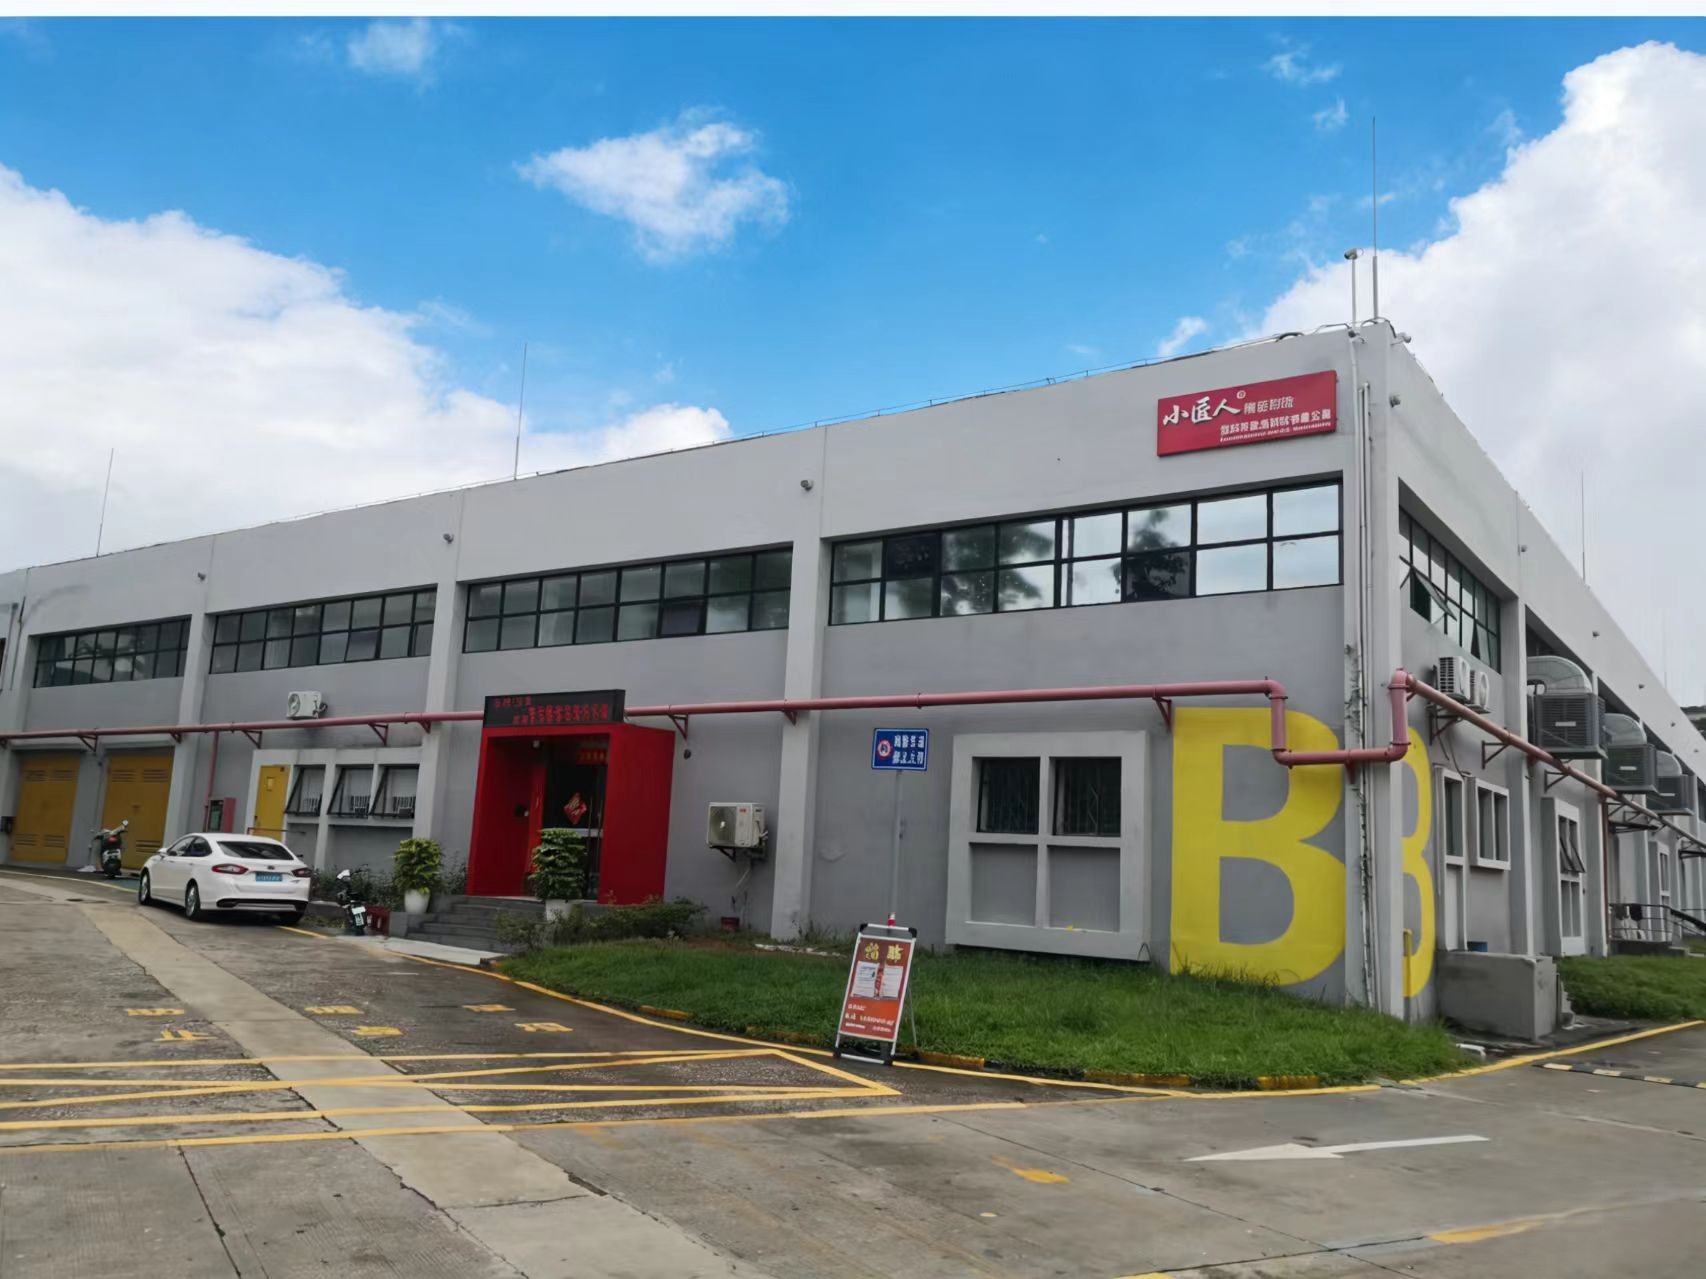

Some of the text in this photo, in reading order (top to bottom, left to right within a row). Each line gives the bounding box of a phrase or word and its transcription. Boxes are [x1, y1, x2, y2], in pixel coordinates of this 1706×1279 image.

[1163, 396, 1240, 426] 小匠人
[1170, 707, 1346, 986] B
